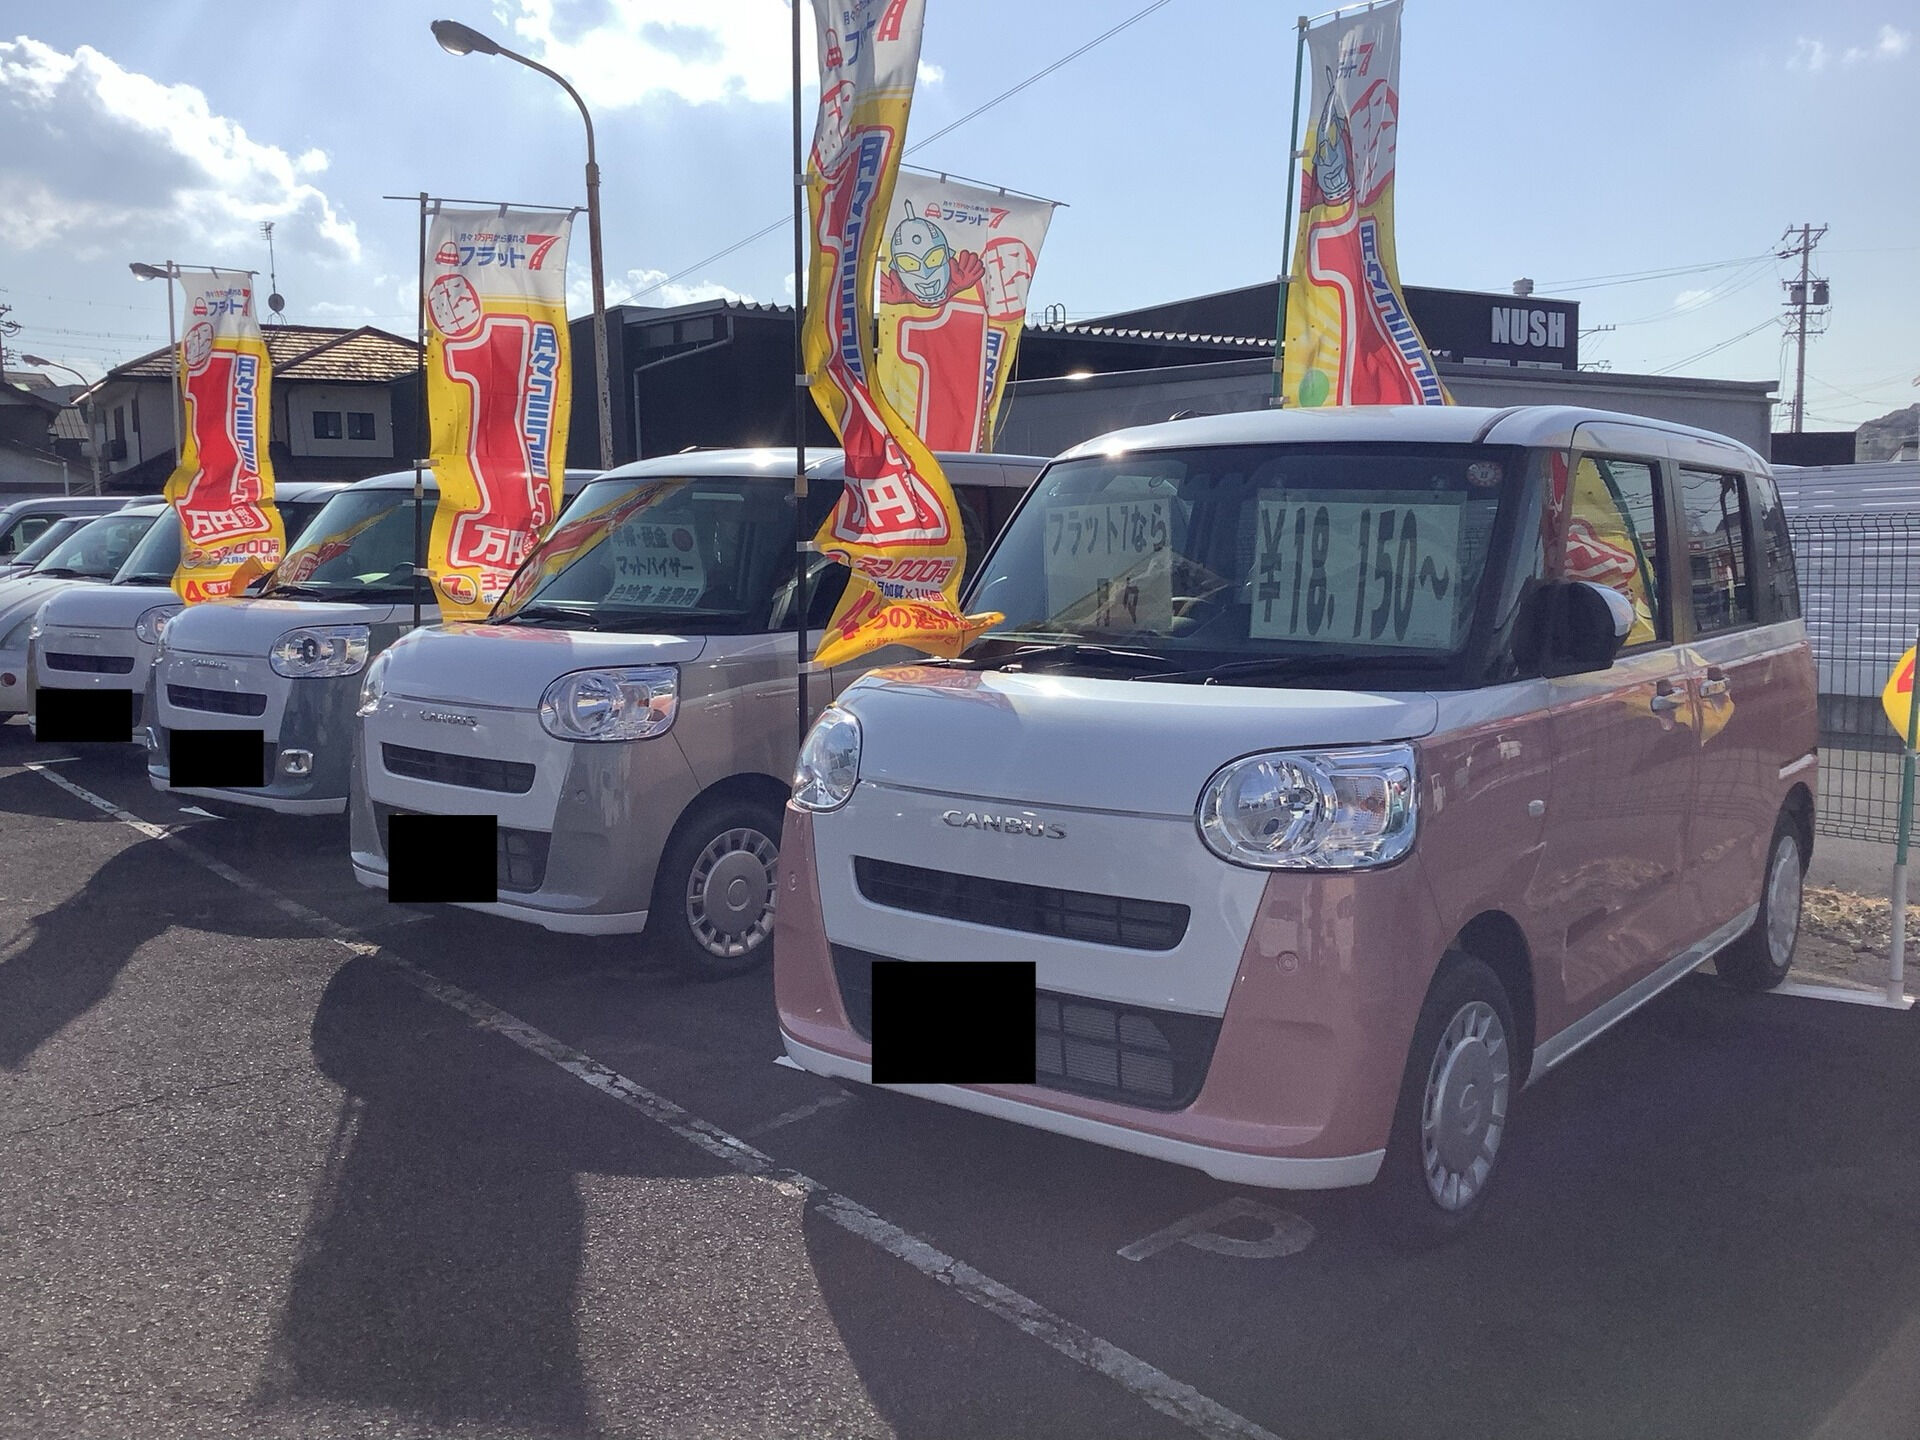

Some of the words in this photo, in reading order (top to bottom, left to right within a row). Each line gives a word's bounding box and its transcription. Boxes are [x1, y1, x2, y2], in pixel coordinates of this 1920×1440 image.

[1491, 306, 1566, 348] NUSH
[236, 357, 258, 472] 月々コミコミ
[527, 327, 556, 476] 月々コミコミ
[186, 509, 243, 538] 万円
[942, 809, 1067, 840] CANBUS
